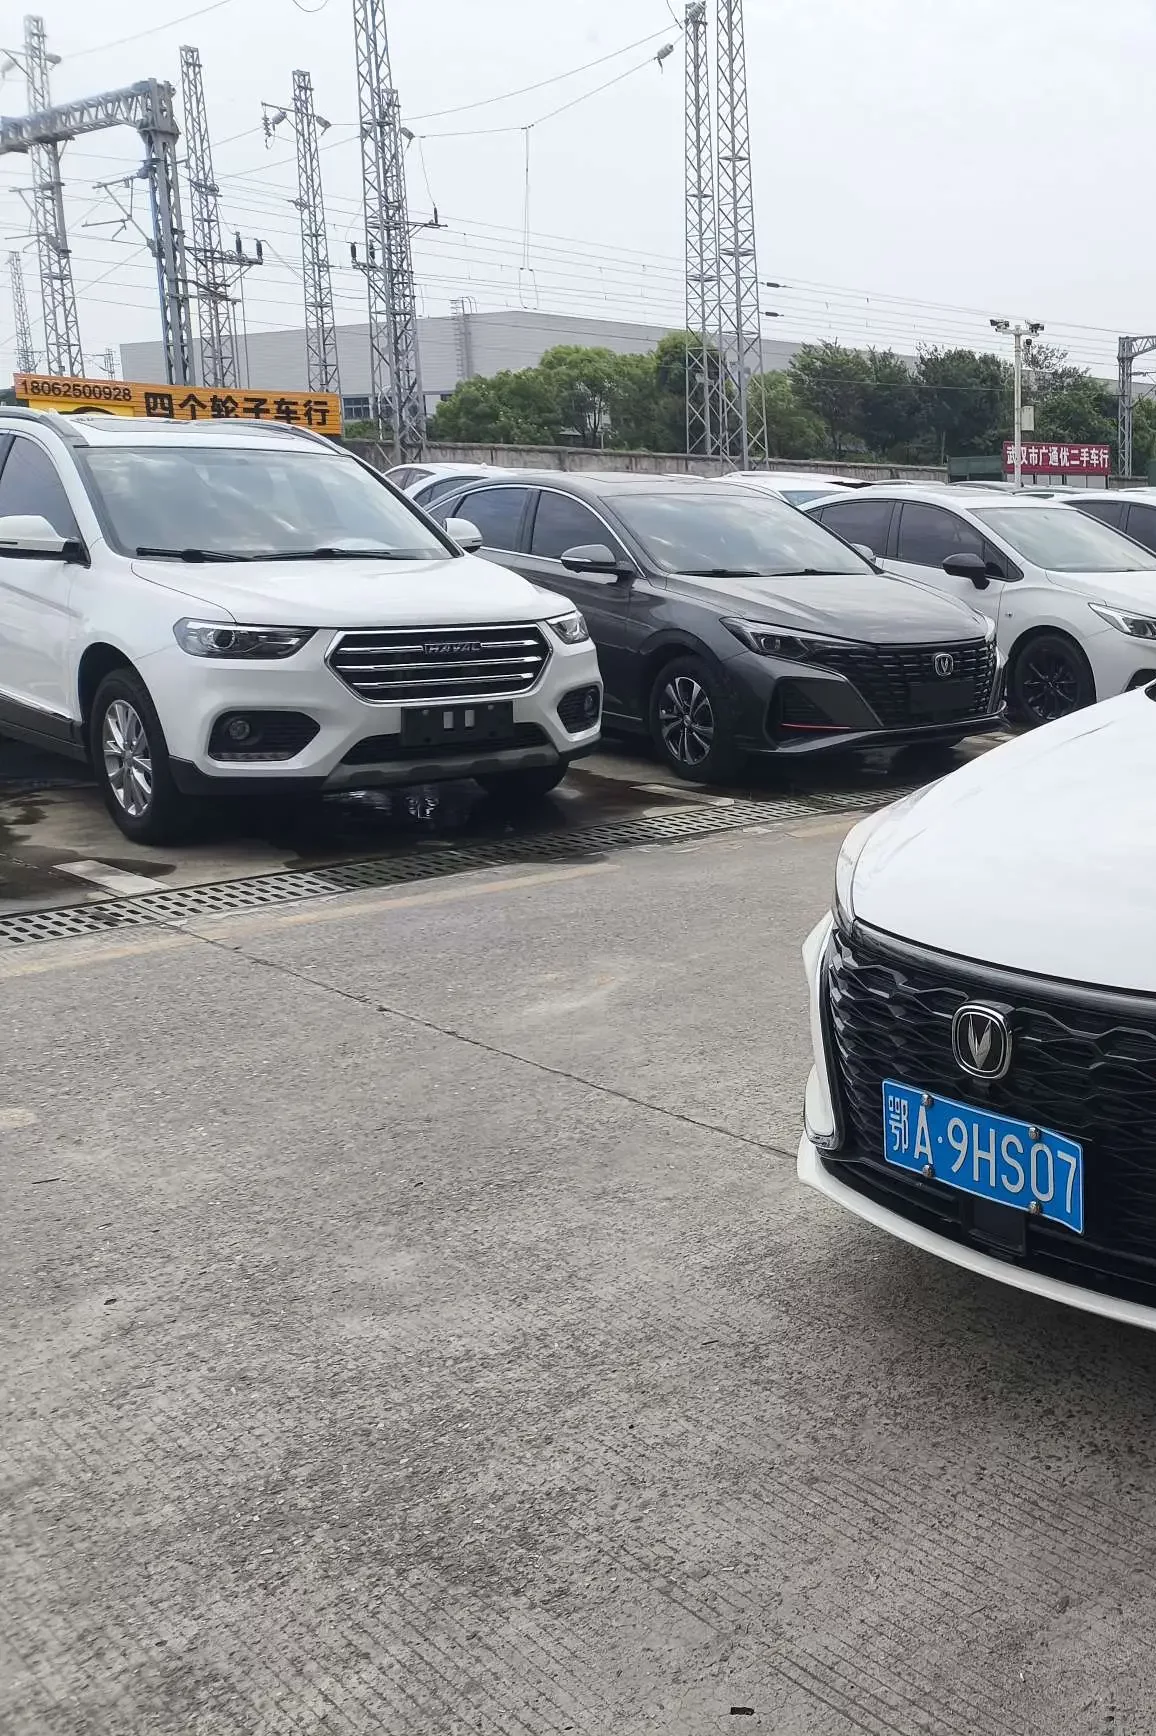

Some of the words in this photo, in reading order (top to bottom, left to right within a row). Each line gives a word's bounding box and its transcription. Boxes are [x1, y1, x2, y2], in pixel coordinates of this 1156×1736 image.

[20, 380, 132, 401] 18062500928
[144, 392, 330, 426] 四个轮子车行
